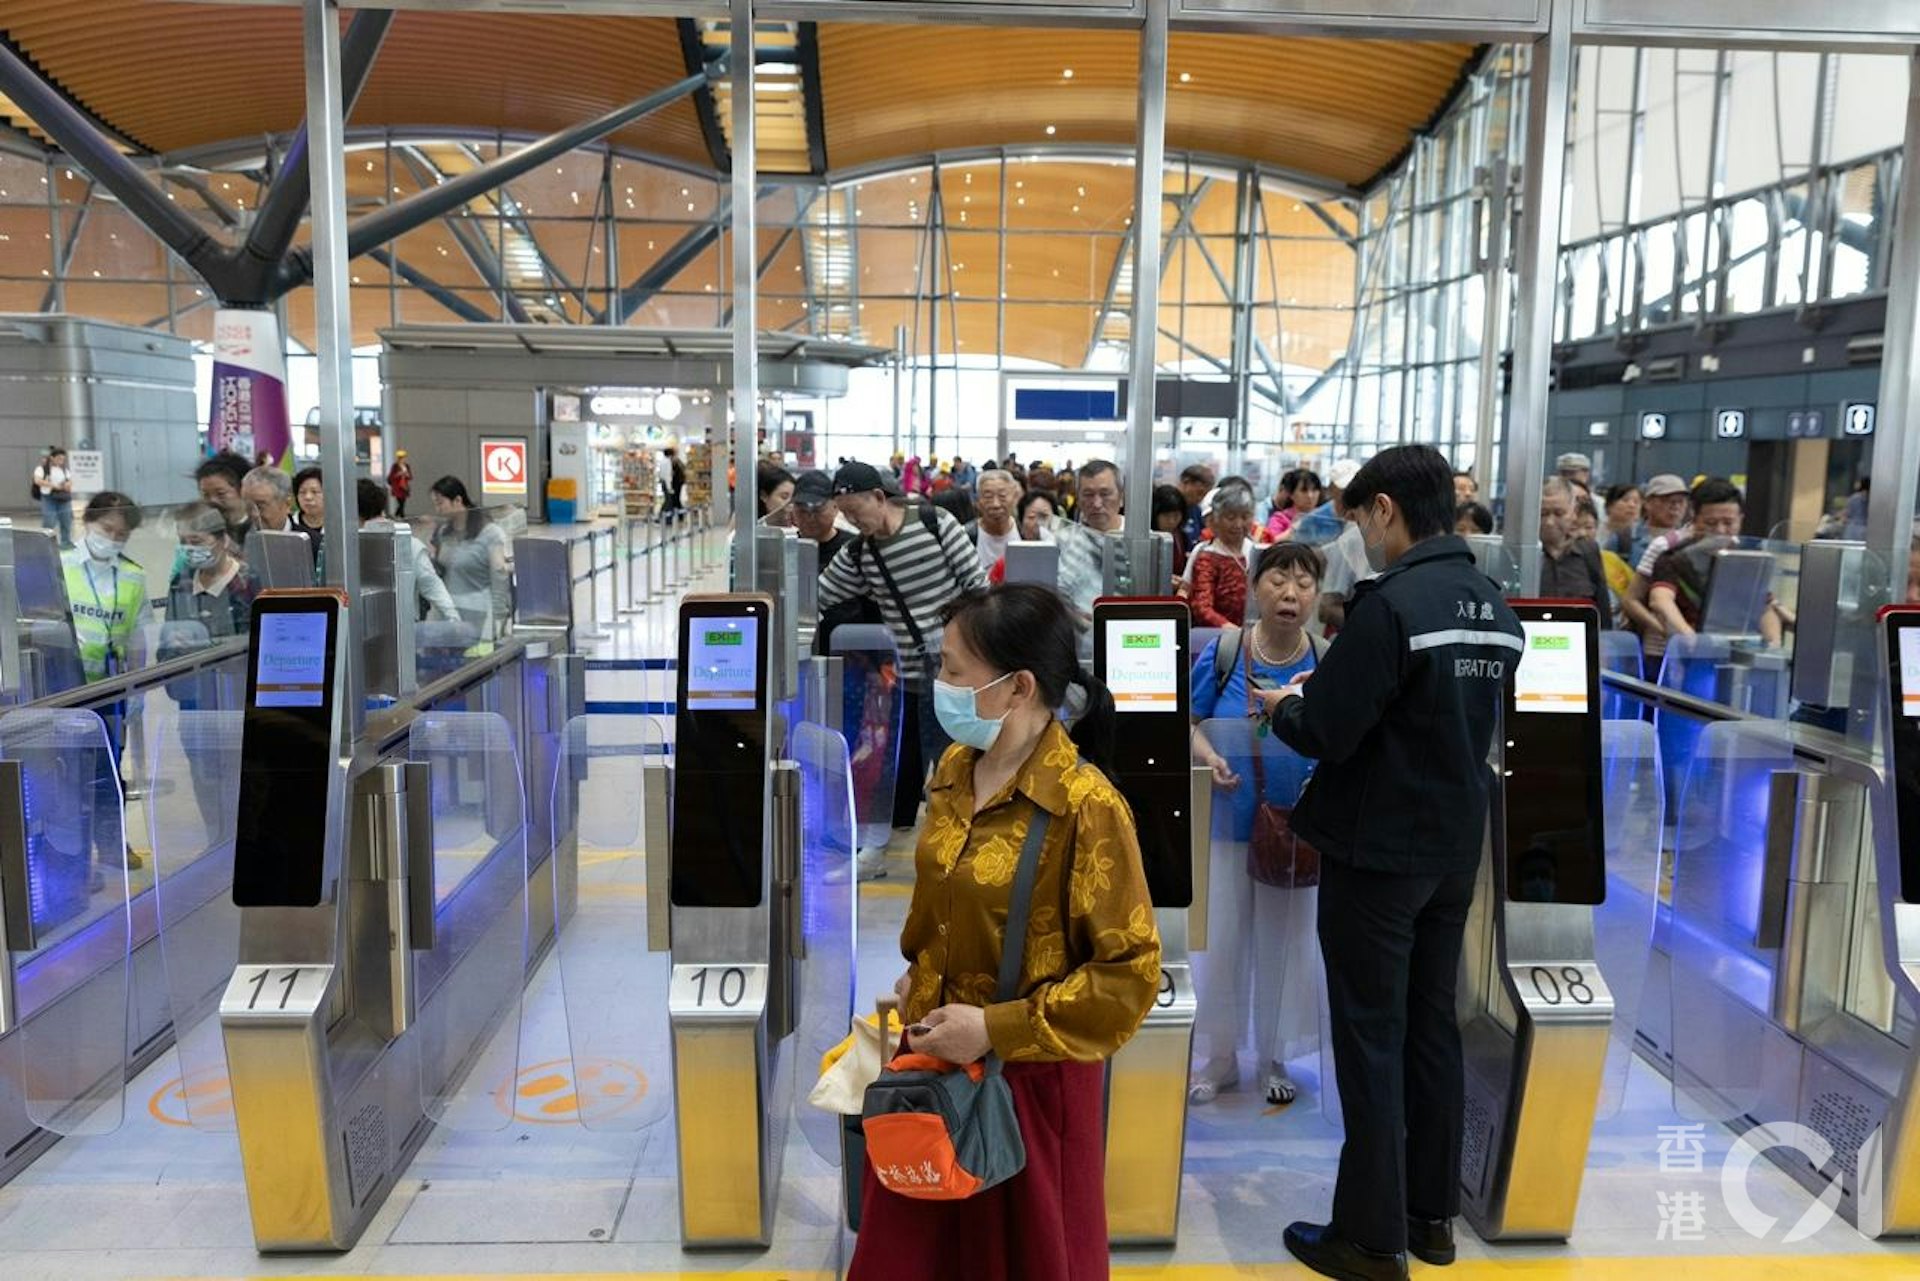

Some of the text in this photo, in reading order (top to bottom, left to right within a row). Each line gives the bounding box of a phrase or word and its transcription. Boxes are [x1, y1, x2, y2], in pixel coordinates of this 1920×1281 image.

[709, 631, 741, 642] EXIT
[1126, 635, 1158, 644] EXIT
[1535, 636, 1568, 646] EXIT
[248, 968, 301, 1009] 11
[691, 967, 746, 1007] 10
[1158, 968, 1176, 1008] 9
[1530, 966, 1593, 1005] 08
